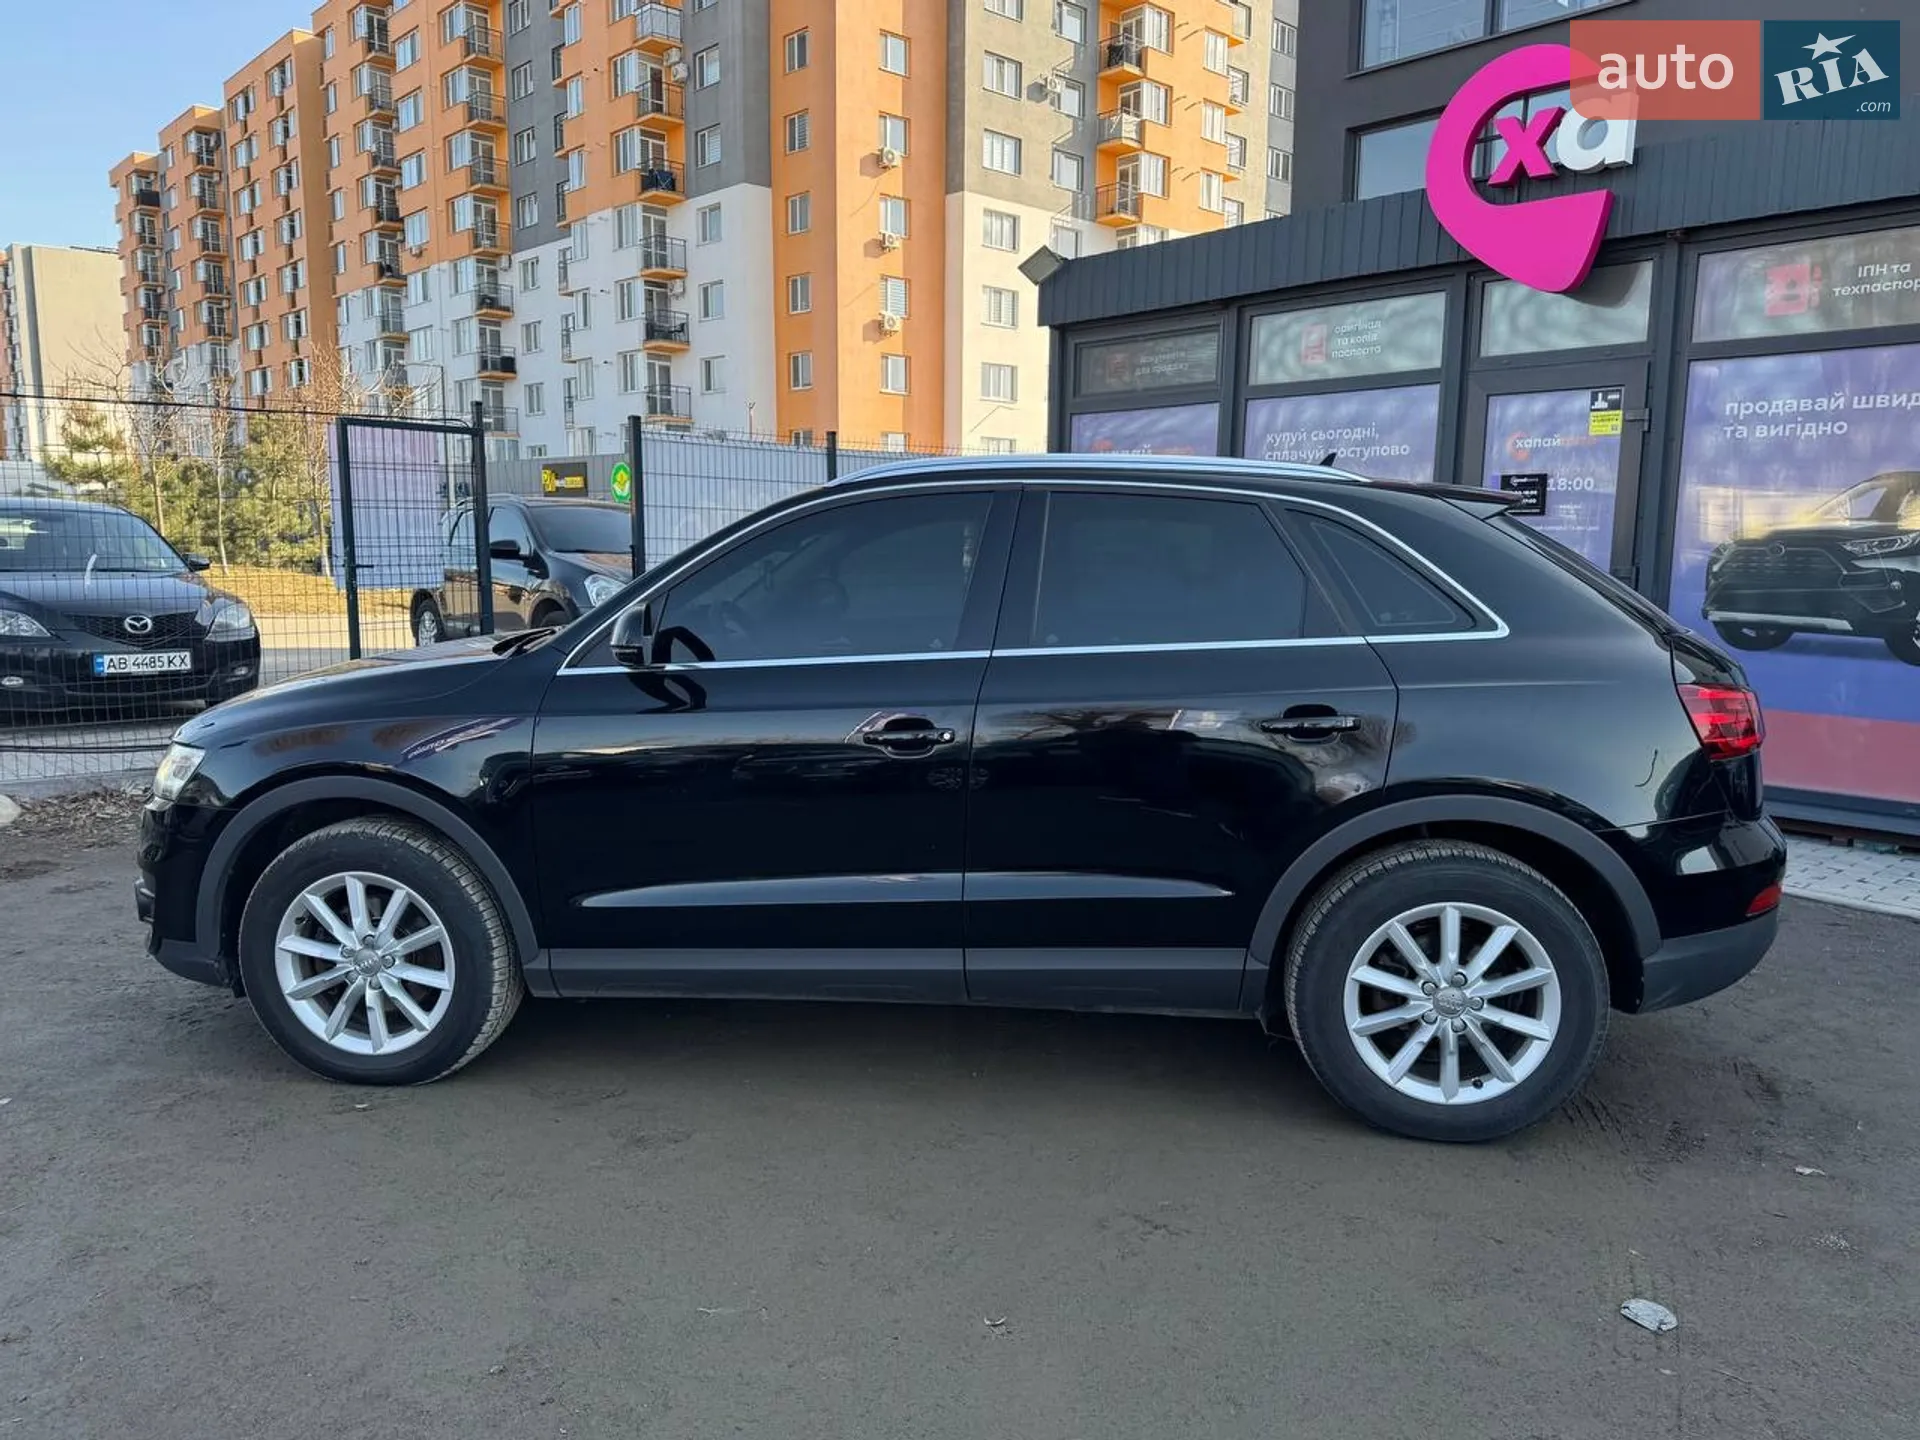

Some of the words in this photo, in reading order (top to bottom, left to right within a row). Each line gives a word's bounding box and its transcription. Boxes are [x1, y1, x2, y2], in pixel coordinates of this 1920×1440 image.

[1890, 262, 1912, 274] та
[1725, 392, 1846, 420] продавай
[1311, 421, 1380, 442] сьогодні,
[1724, 424, 1748, 439] та
[1755, 418, 1848, 440] вигідно
[1265, 444, 1325, 463] сплачуй
[107, 657, 128, 671] AB
[132, 655, 165, 669] 4485
[167, 654, 188, 668] KX
